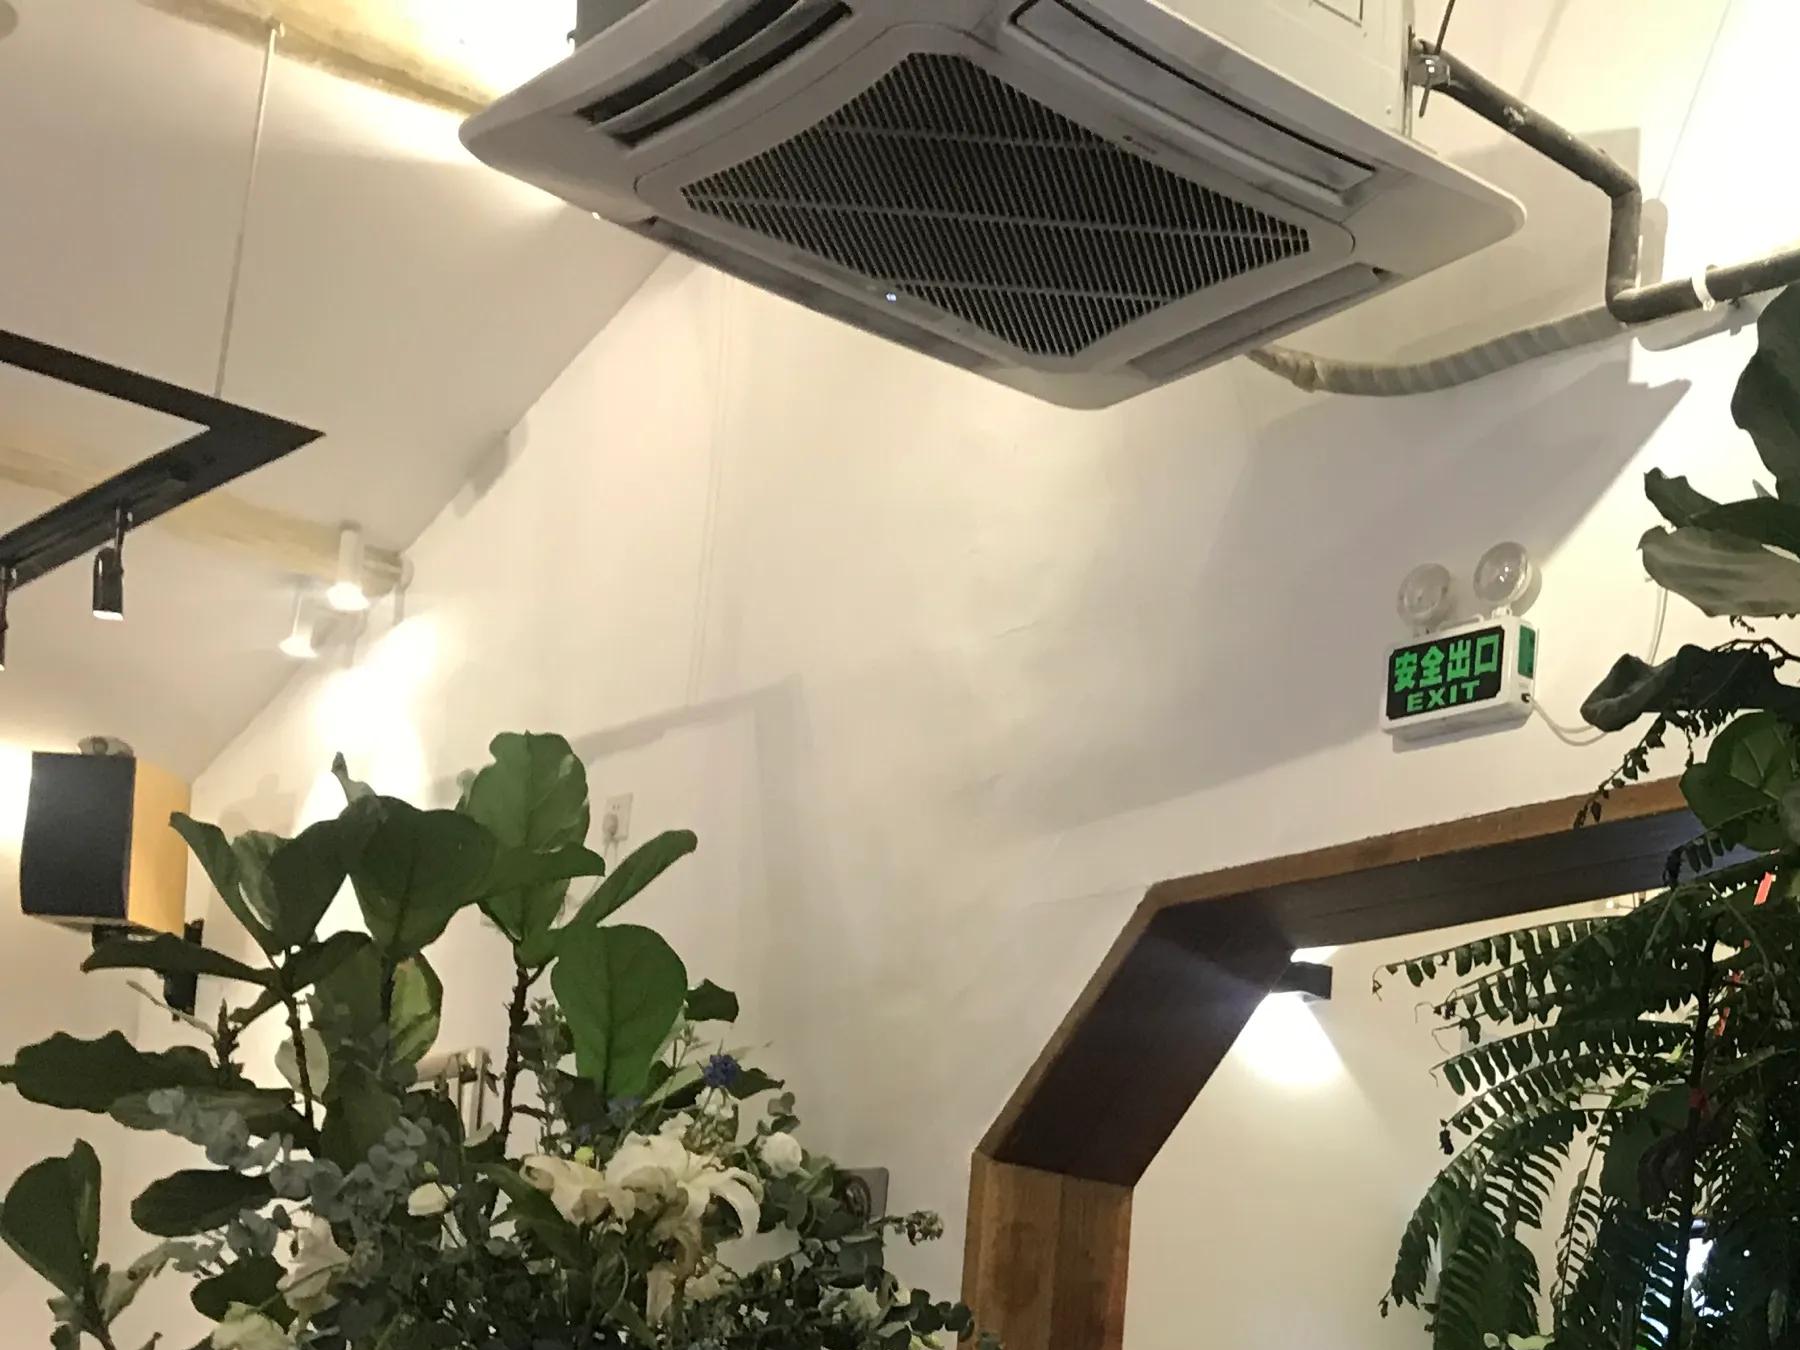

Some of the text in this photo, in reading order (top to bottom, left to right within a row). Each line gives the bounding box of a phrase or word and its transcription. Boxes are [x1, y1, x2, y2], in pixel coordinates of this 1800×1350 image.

[1394, 634, 1499, 693] 安全出口
[1407, 680, 1480, 712] EXIT
